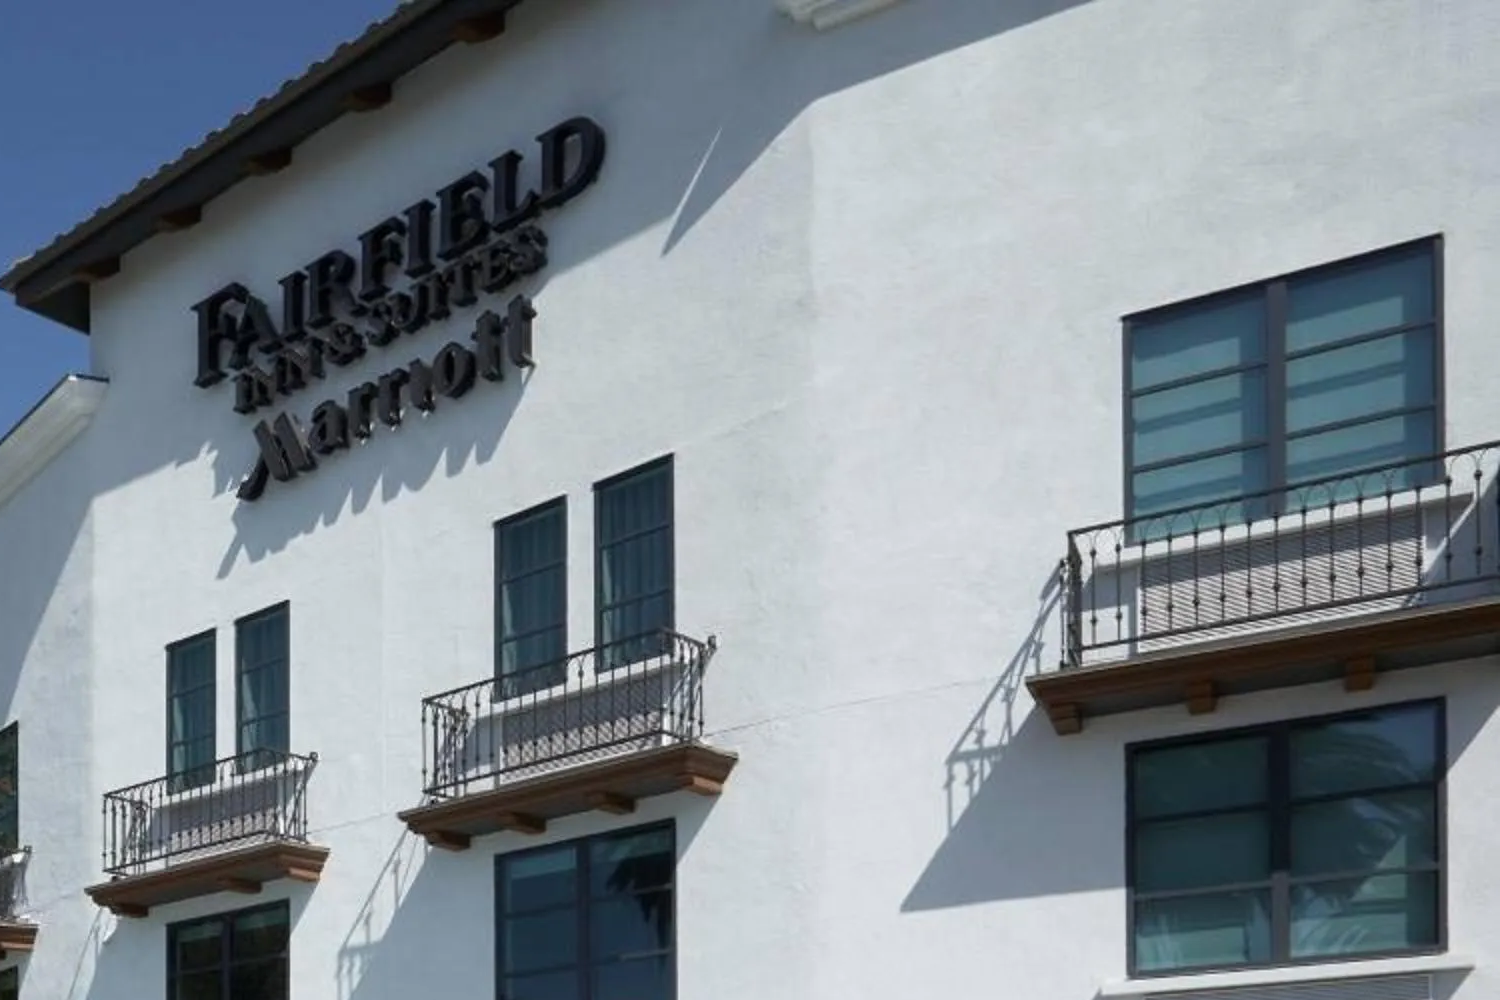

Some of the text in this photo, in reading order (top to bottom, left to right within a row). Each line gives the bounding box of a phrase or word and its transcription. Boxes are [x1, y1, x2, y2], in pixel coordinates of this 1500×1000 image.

[191, 116, 607, 388] FAIRFIELD
[323, 322, 368, 366] &
[366, 224, 548, 347] SUITES
[236, 294, 537, 501] Marriott
